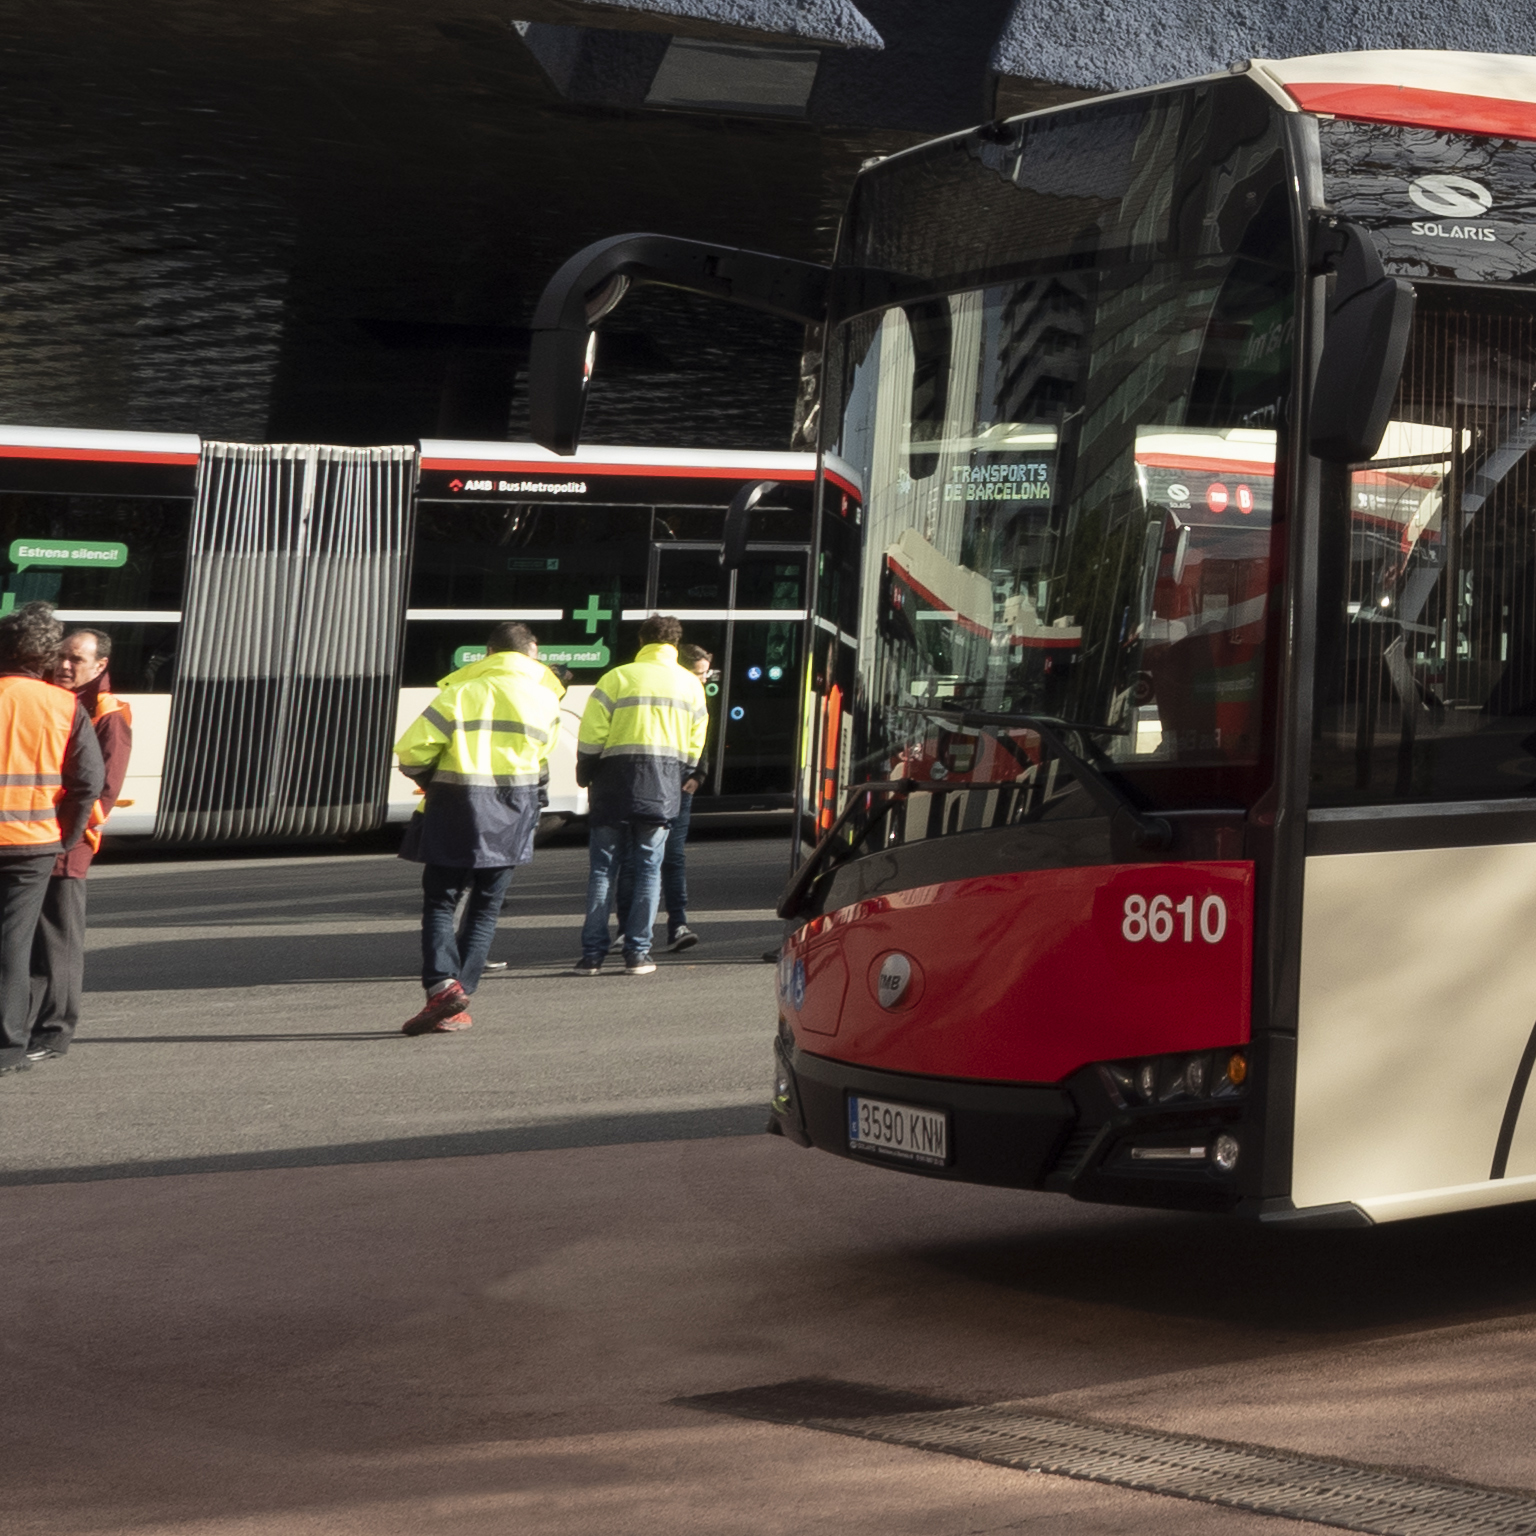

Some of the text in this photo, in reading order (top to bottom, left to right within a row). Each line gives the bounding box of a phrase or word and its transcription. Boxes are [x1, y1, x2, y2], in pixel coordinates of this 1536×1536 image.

[1411, 221, 1496, 242] SOLARIS
[952, 464, 1048, 483] TRANSPORTS
[464, 479, 587, 495] AMB Bus Metropolità
[944, 482, 1051, 502] DE BARCELONA
[18, 545, 119, 561] Estrena silenci!
[548, 650, 572, 662] més
[573, 651, 602, 662] neta!
[1122, 894, 1227, 943] 8610
[861, 1103, 904, 1146] 3590
